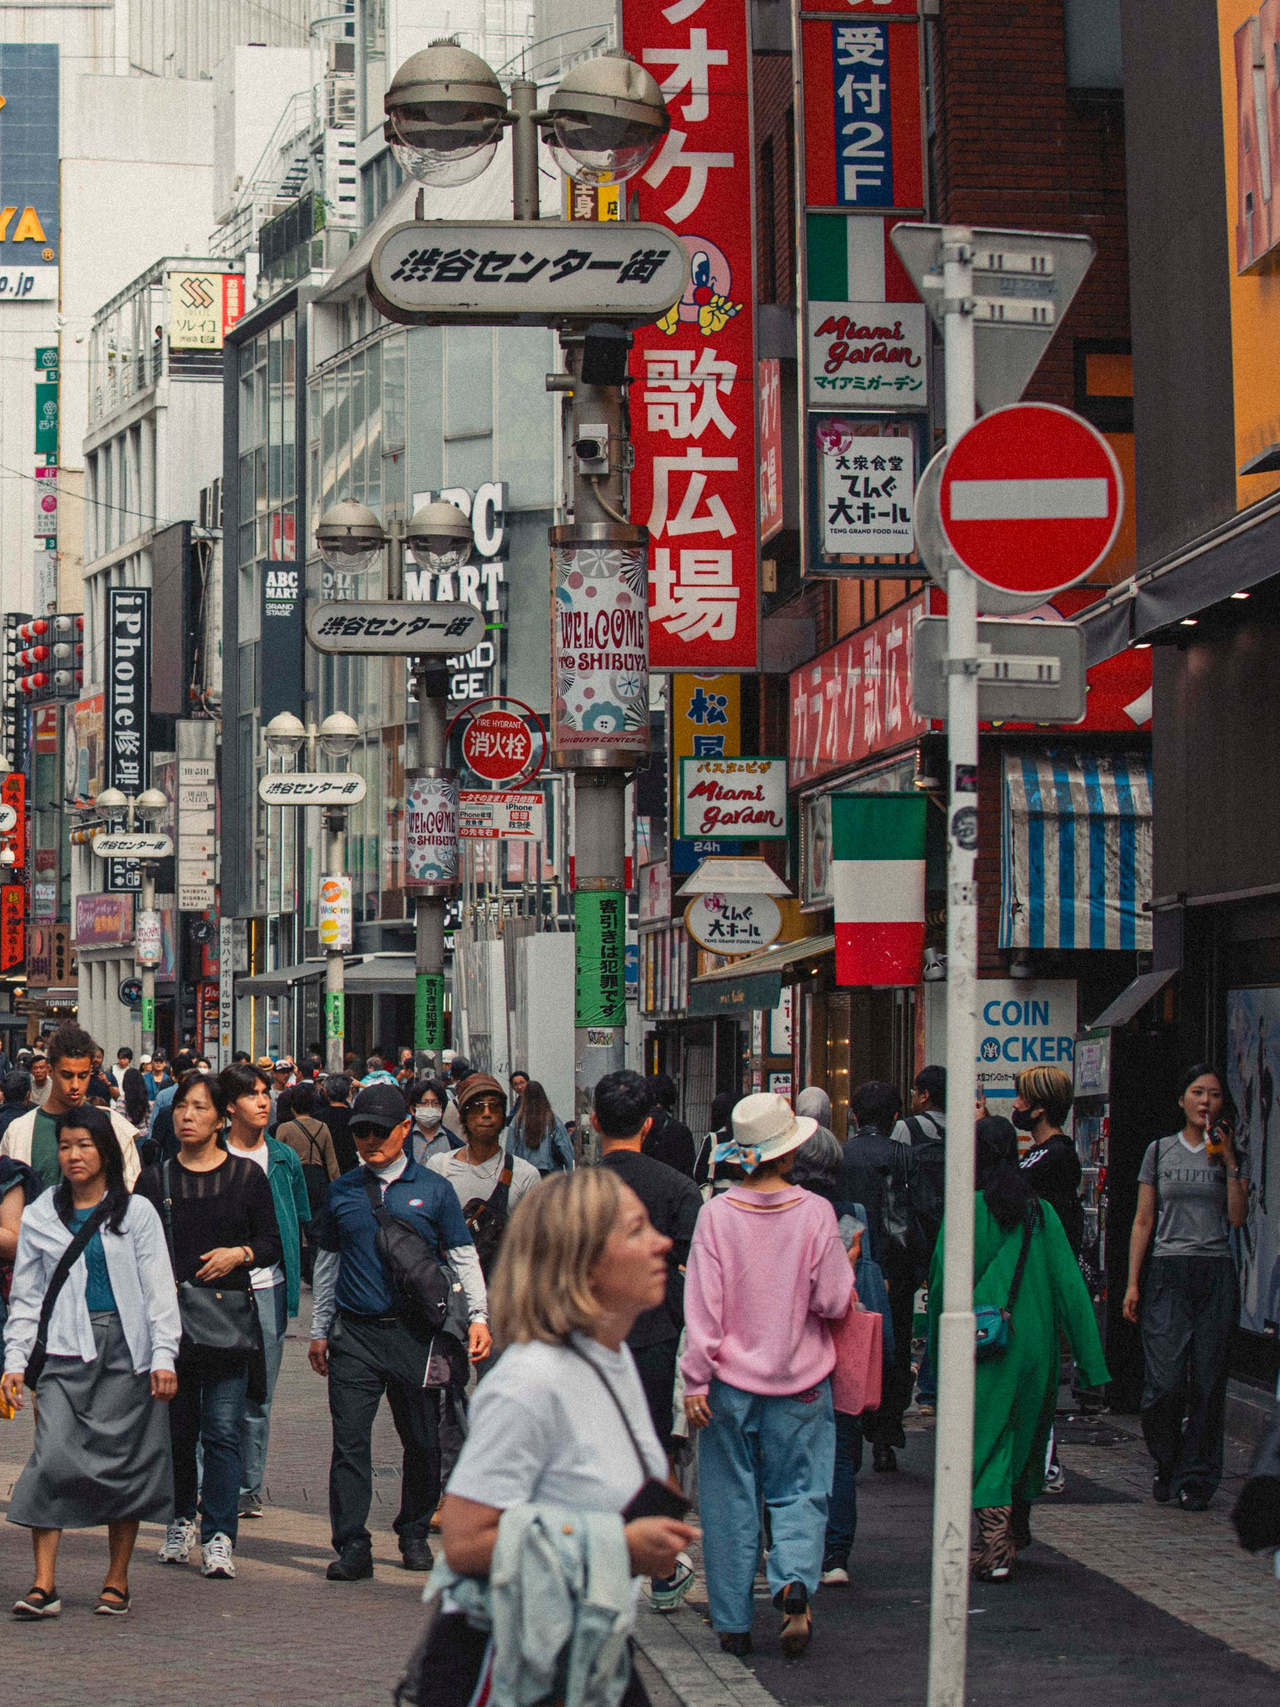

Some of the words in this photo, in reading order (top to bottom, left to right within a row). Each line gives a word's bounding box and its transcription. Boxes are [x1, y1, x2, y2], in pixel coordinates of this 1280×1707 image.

[390, 247, 671, 284] 渋谷センター街
[176, 319, 218, 332] ソレイユ
[814, 315, 905, 341] Miami
[813, 375, 923, 392] マイアミガーデン
[835, 454, 905, 472] 大衆食堂
[643, 346, 741, 643] 歌広場
[839, 474, 898, 499] てんぐ
[827, 496, 911, 526] 大ホール
[829, 527, 848, 535] TENG
[848, 527, 872, 535] GRAND
[872, 527, 892, 535] FOOD
[892, 527, 910, 535] HALL
[265, 571, 299, 588] ABC
[265, 587, 299, 599] MART
[265, 602, 295, 611] GRAND
[265, 609, 292, 617] STAGE
[317, 616, 475, 638] 渋谷センター街
[560, 608, 645, 650] WELCOME
[577, 652, 649, 673] SHIBUYA
[792, 603, 922, 778] カラオケ歌広
[476, 717, 491, 728] FIRE
[492, 717, 522, 730] HYDRANT
[469, 730, 527, 760] 消火栓
[559, 736, 600, 745] SHIBUYA
[265, 781, 359, 795] 渋谷センター街
[688, 780, 765, 802] Miami
[505, 803, 533, 811] iPhone
[408, 811, 457, 834] WELCOME
[417, 835, 458, 847] SHIBUYA
[460, 828, 493, 836] の先を右
[96, 840, 168, 851] 渋谷センター街
[693, 841, 721, 852] 24h
[720, 903, 754, 922] てんぐ
[708, 921, 762, 938] 大ホール
[599, 898, 619, 1018] 客引きは犯罪です
[982, 1000, 1050, 1026] COIN
[976, 1036, 1073, 1063] OCKER
